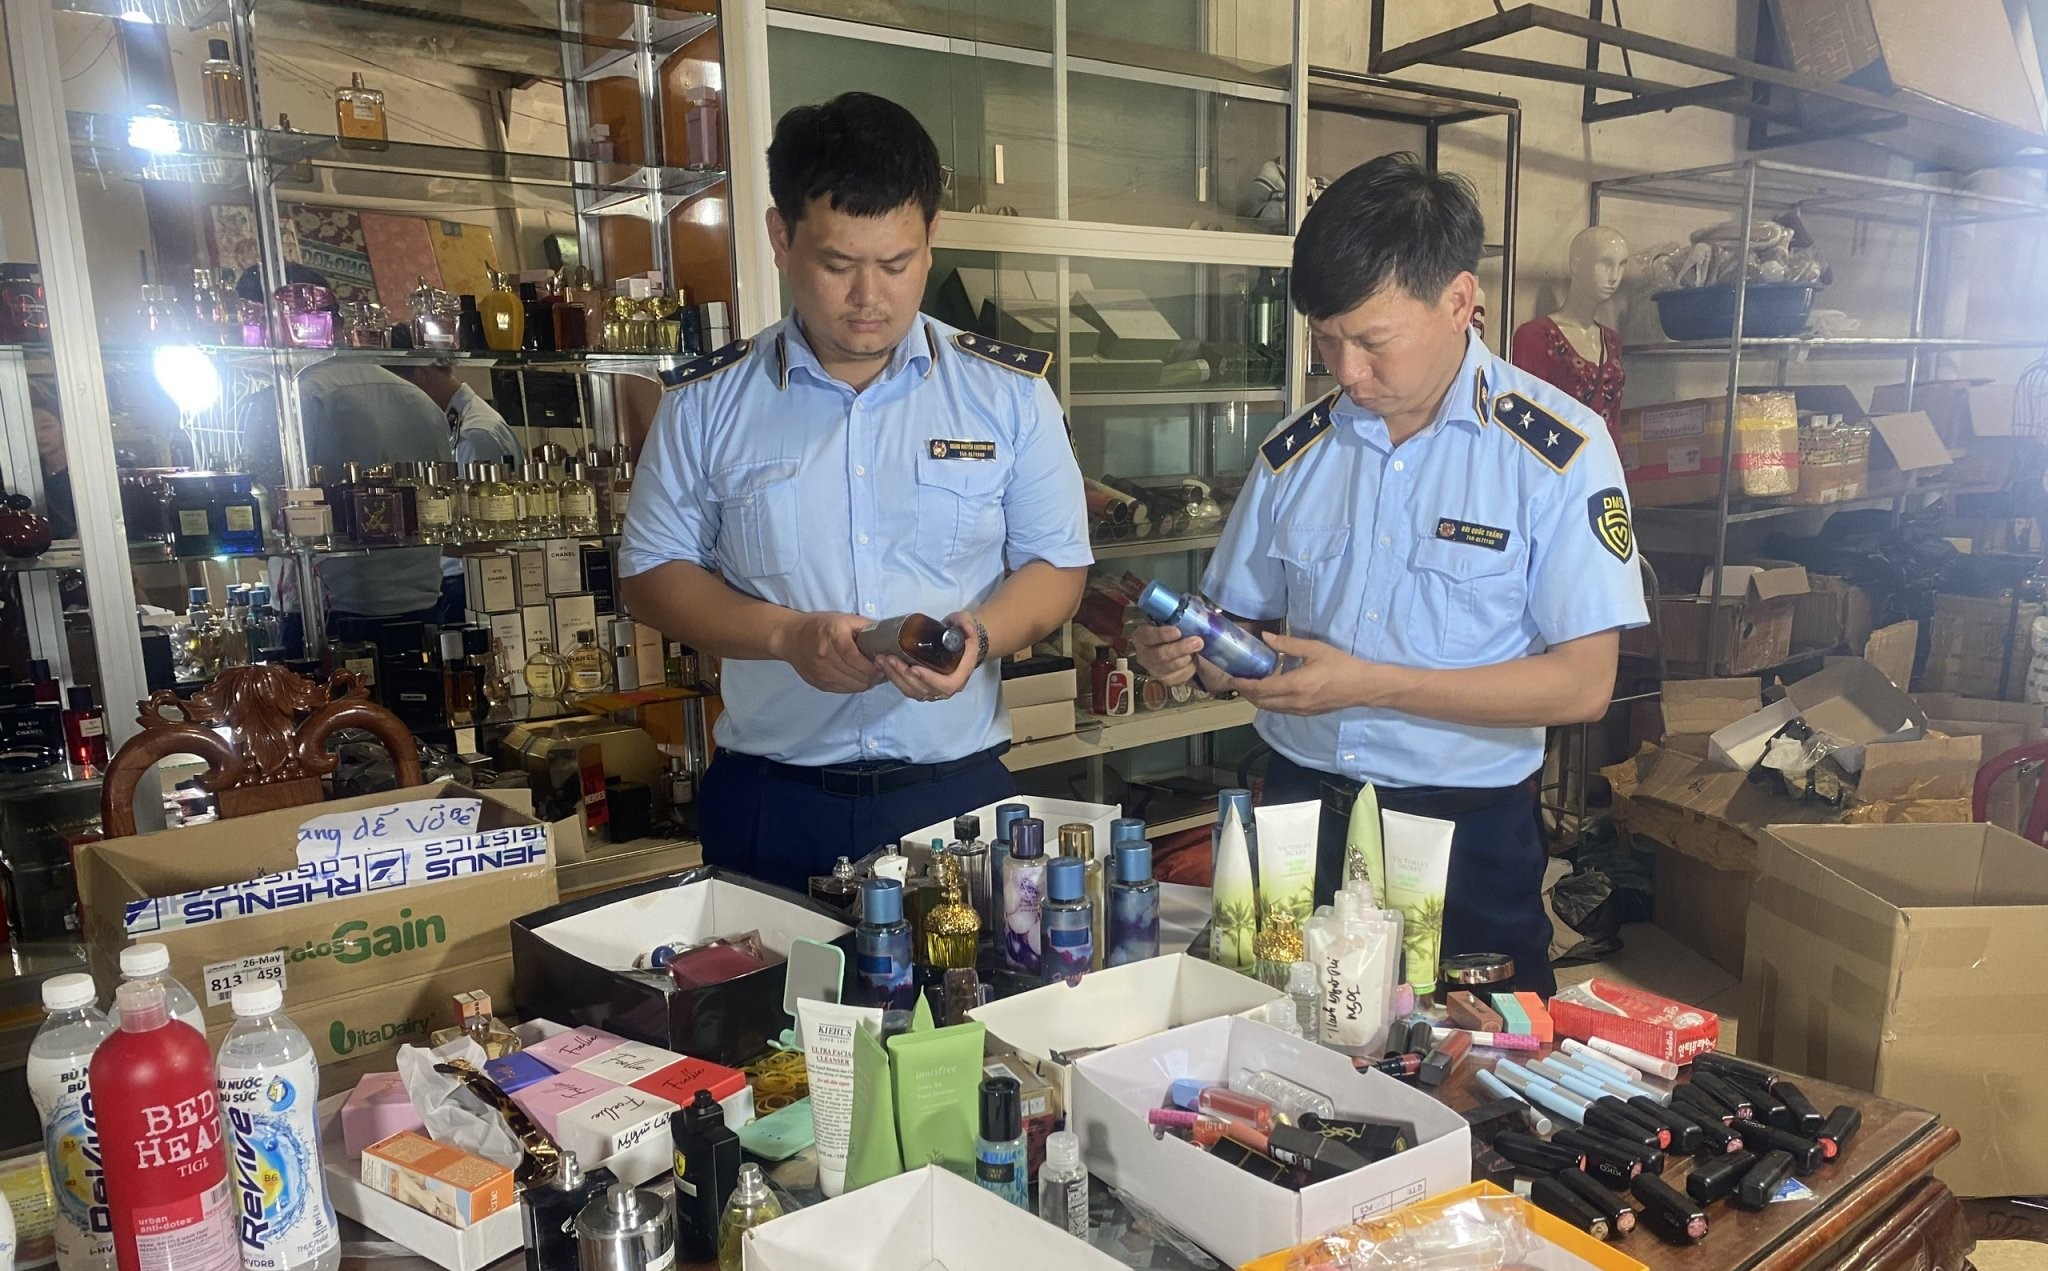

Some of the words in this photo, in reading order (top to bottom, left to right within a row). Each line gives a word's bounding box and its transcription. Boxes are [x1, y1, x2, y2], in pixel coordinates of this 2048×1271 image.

[1603, 496, 1624, 509] DMS
[183, 874, 361, 925] RHENUS
[243, 954, 281, 968] 26-May
[257, 966, 282, 980] 459
[211, 974, 243, 992] 813
[329, 1014, 430, 1055] VitaDairy
[818, 1025, 852, 1037] KIEHL'S
[811, 1045, 831, 1056] ULTRA
[832, 1048, 854, 1058] FACIA
[816, 1055, 850, 1064] CLEANSER
[61, 1069, 79, 1083] BÙ
[227, 1076, 263, 1090] NƯỚC
[67, 1079, 86, 1094] BÙ
[140, 1089, 214, 1137] BED
[134, 1115, 222, 1169] HEAD
[1600, 1164, 1622, 1176] KIKO
[264, 1174, 278, 1182] B6
[138, 1216, 168, 1226] urban
[140, 1217, 192, 1233] anti-dotes
